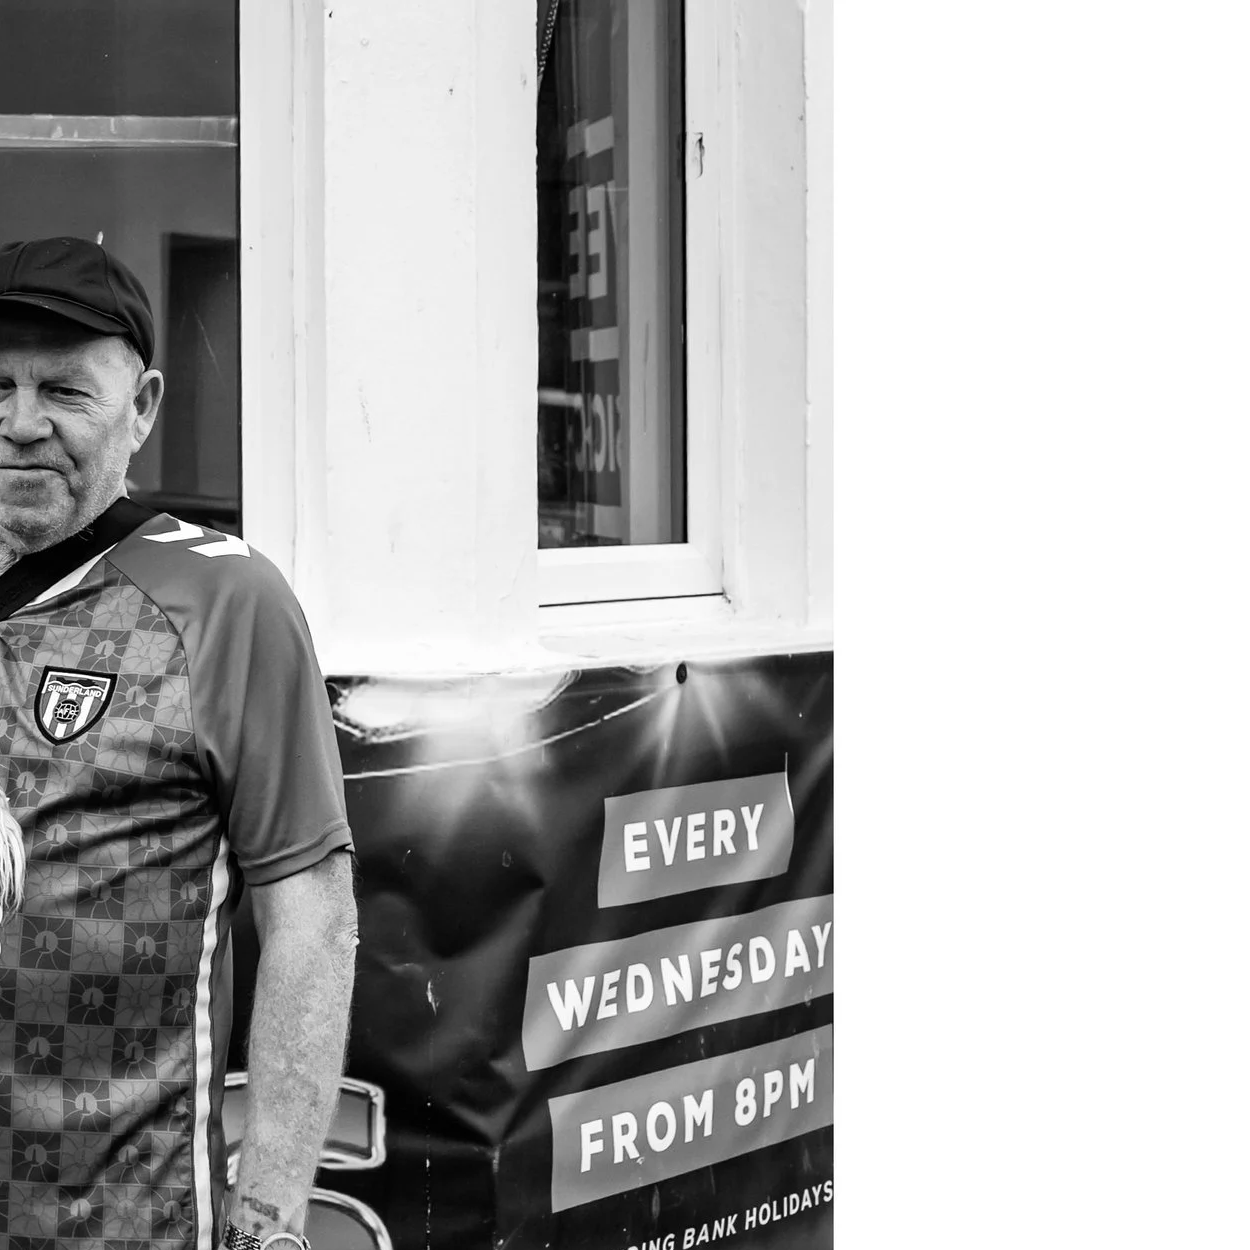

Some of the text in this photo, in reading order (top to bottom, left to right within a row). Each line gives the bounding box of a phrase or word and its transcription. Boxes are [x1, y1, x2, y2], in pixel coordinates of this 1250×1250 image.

[47, 684, 102, 698] SUNDERLAND
[623, 803, 764, 872] EVERY
[547, 921, 833, 1032] WEDNESDAY
[580, 1058, 815, 1173] FROM 8PM
[682, 1214, 738, 1250] BANK
[745, 1180, 833, 1231] HOLIDAYS
